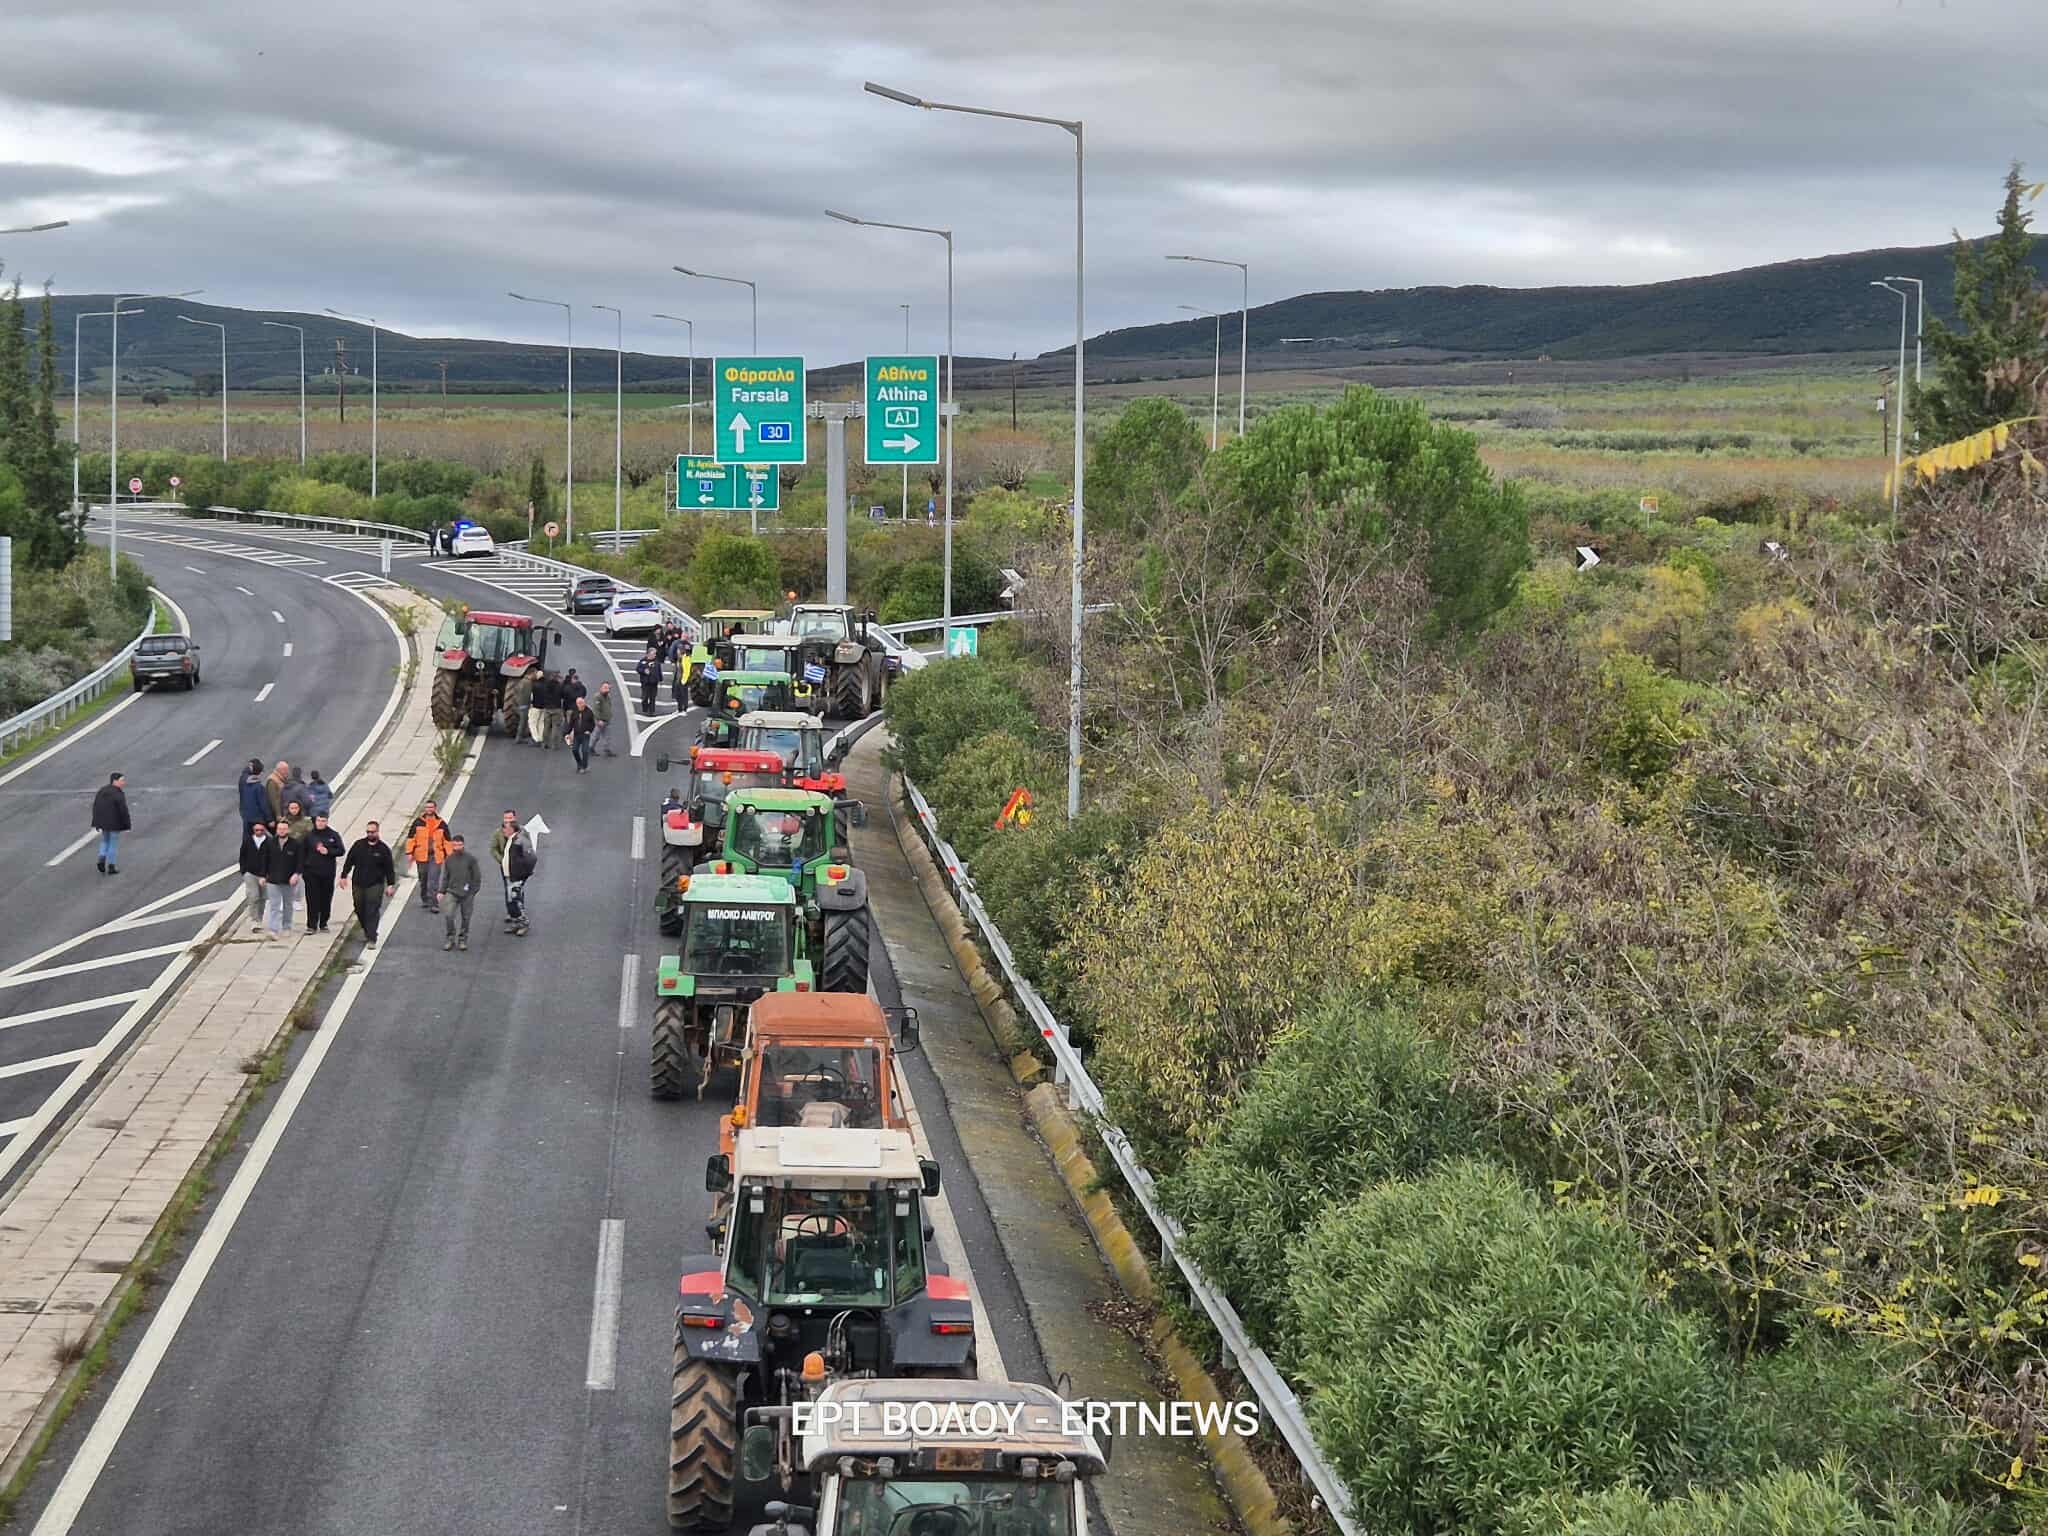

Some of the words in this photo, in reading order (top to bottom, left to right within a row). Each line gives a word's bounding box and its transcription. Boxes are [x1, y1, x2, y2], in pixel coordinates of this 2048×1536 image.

[725, 367, 795, 384] Φάρσαλα
[877, 366, 928, 381] Αθήνα
[732, 387, 789, 402] Farsala
[877, 387, 928, 401] Athina
[895, 410, 910, 424] A1
[767, 426, 783, 439] 30
